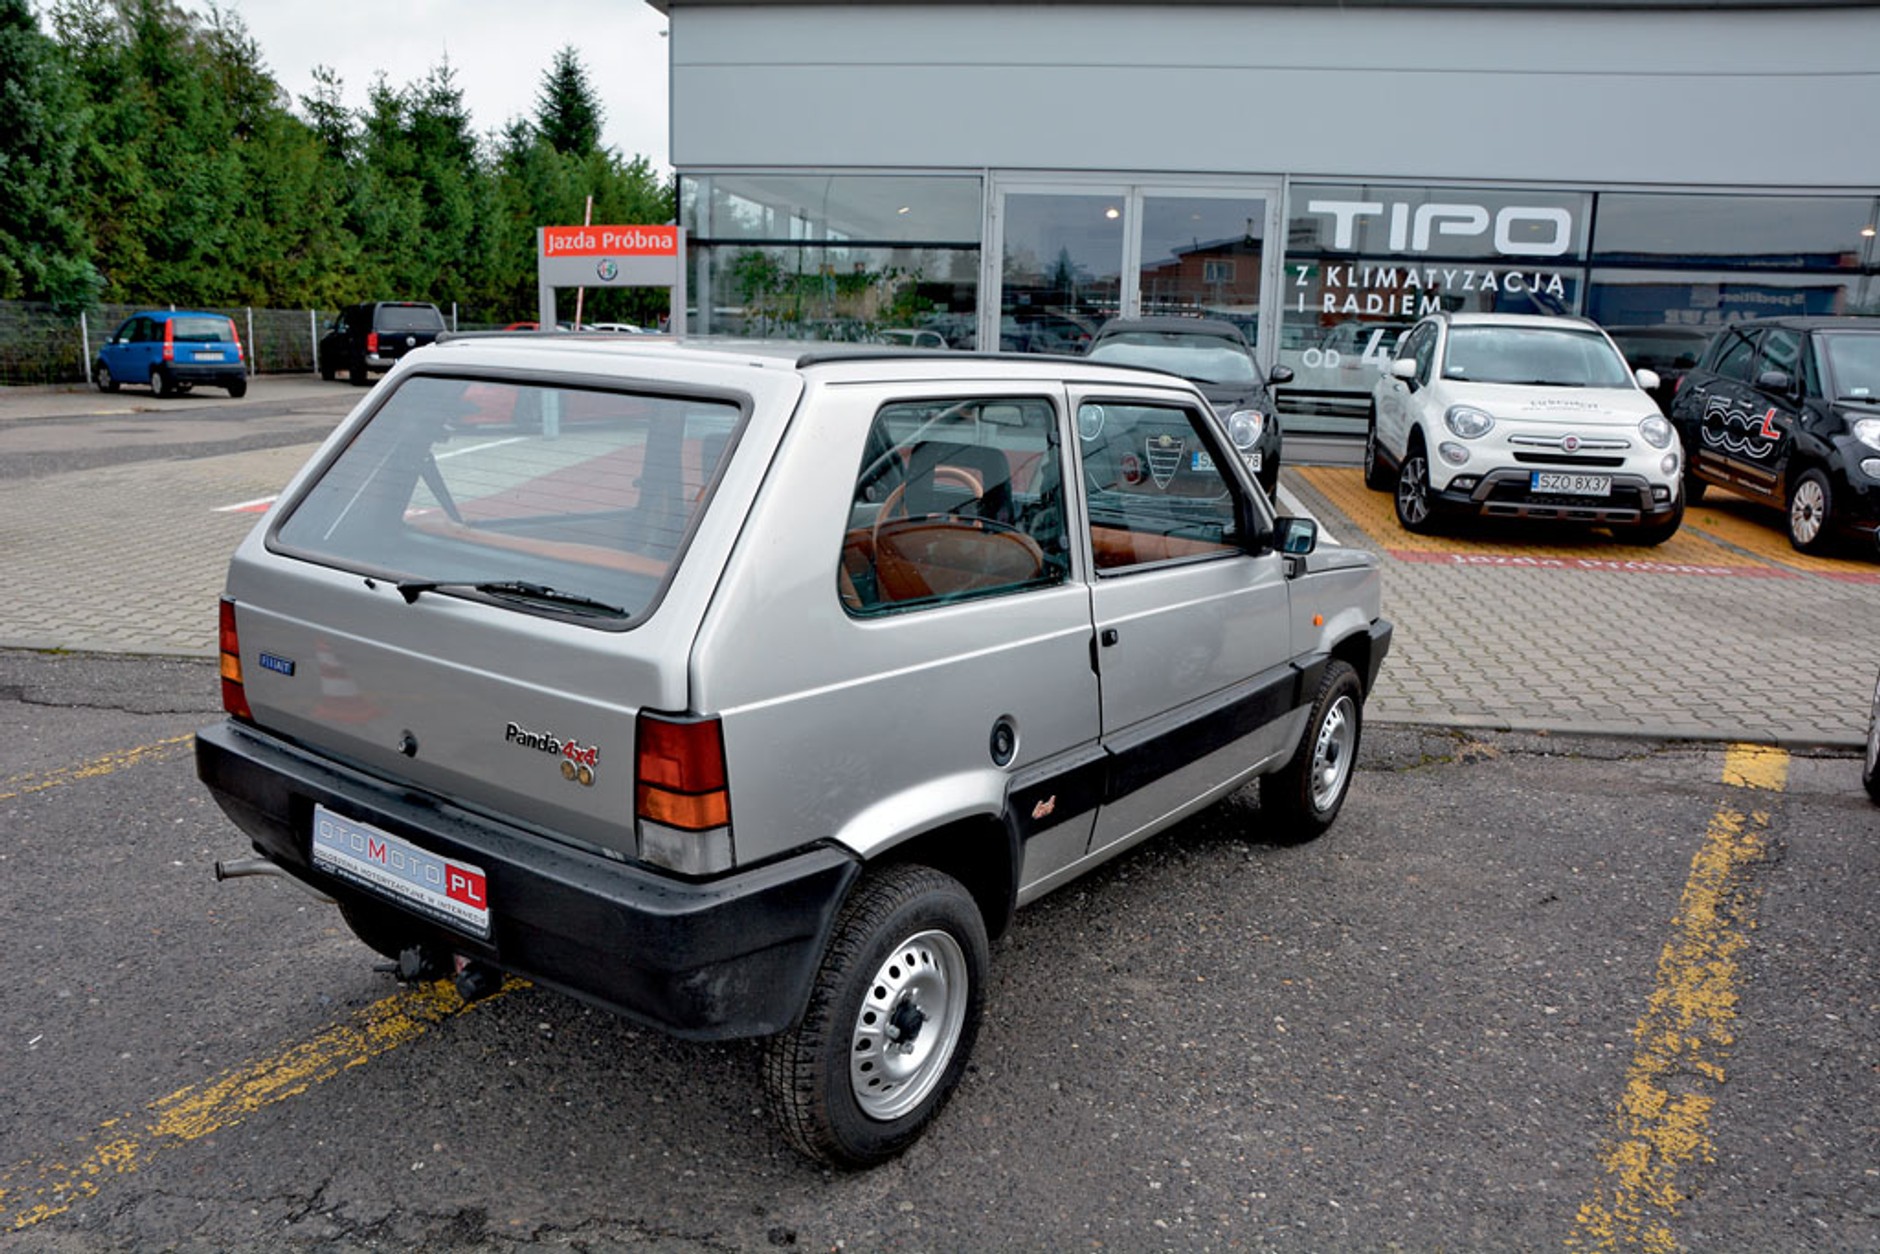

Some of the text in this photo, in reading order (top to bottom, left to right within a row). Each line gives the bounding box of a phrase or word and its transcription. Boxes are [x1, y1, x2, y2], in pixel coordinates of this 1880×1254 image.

[1308, 200, 1572, 256] TIPO
[548, 230, 673, 253] Jazda Próbna
[1296, 266, 1565, 299] Z KLIMATYZACJĄ
[1298, 293, 1441, 316] I RADIEM
[1303, 348, 1340, 369] OD
[1540, 475, 1609, 492] SZO 8X37
[505, 722, 560, 755] Panda
